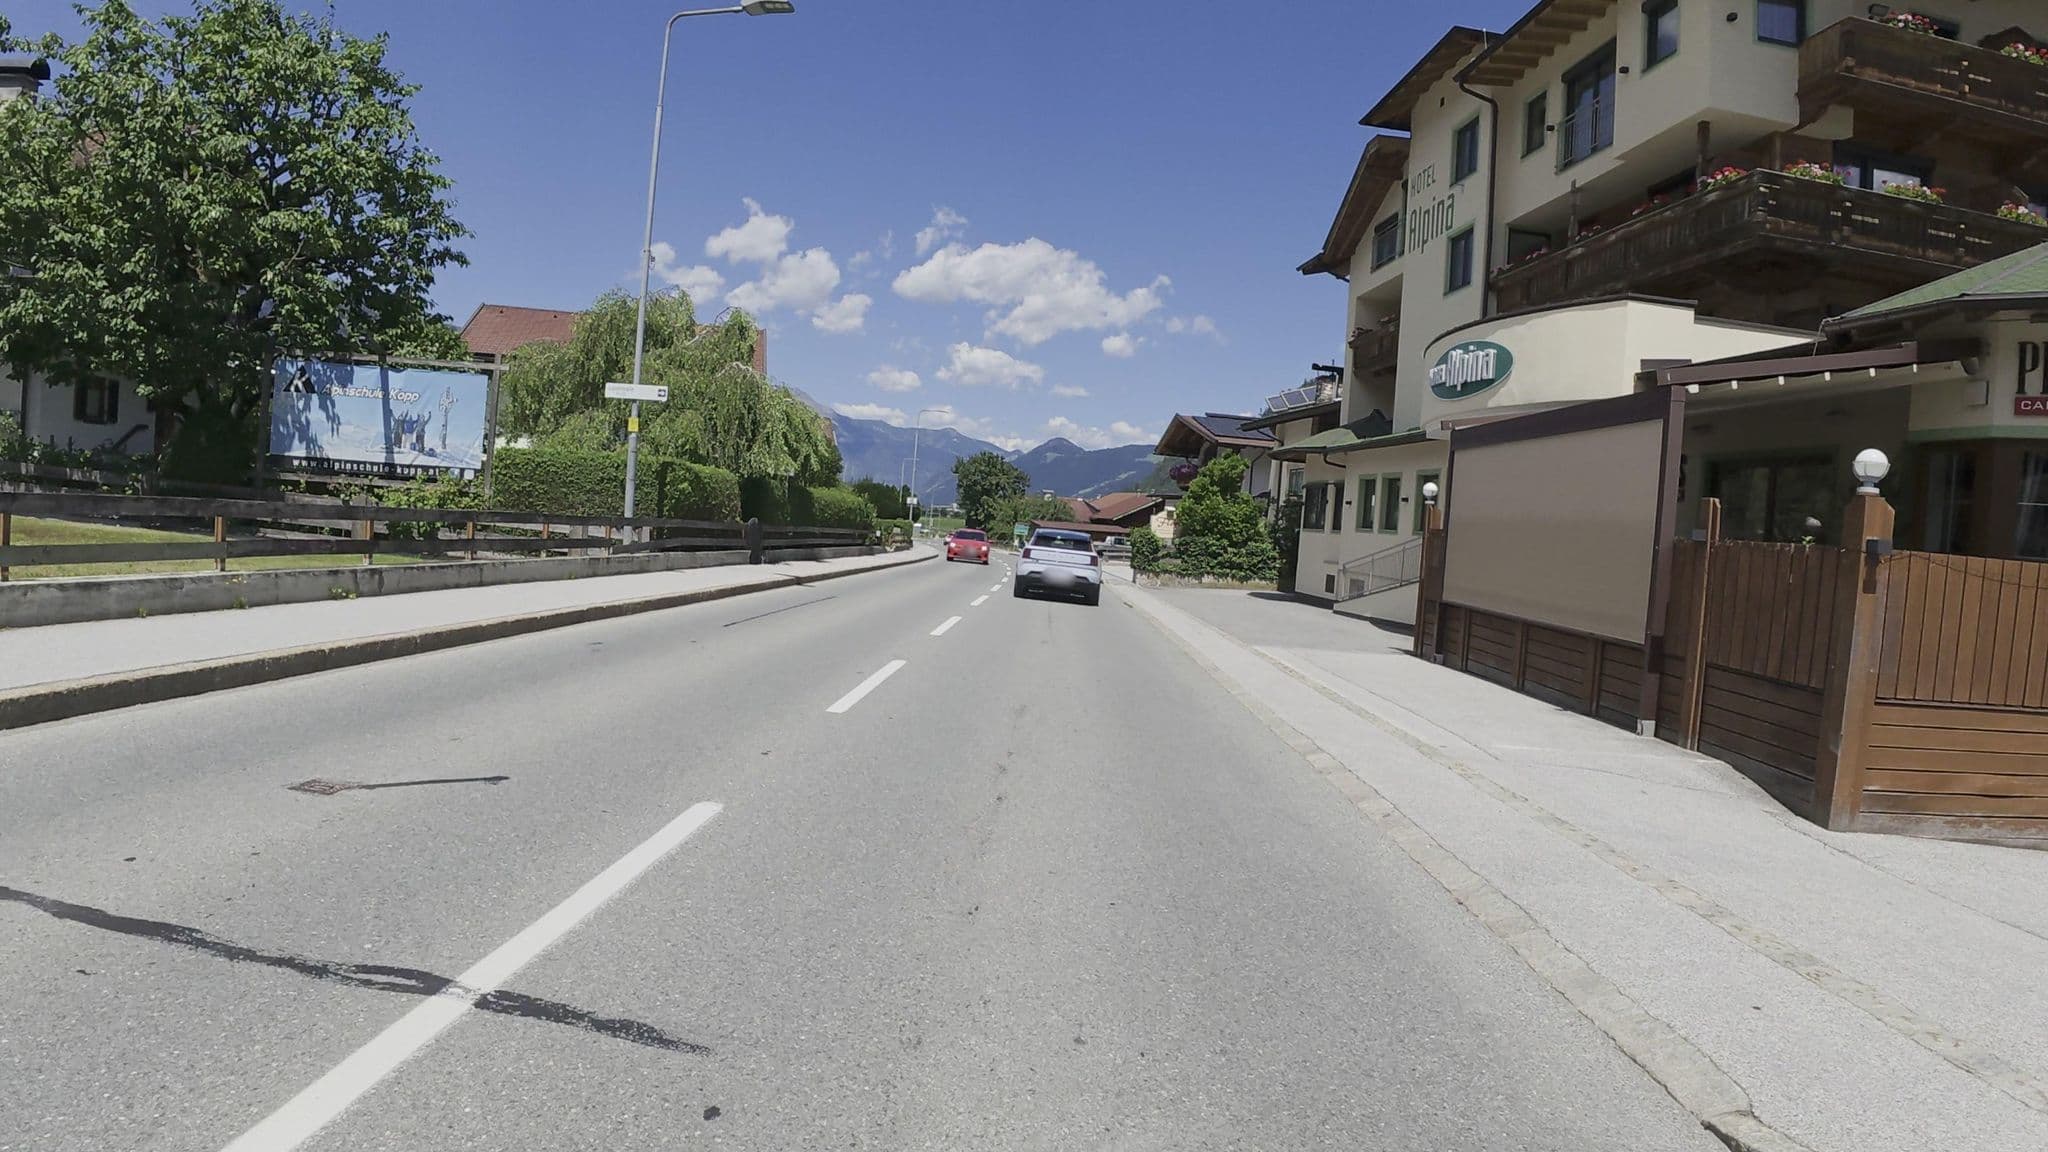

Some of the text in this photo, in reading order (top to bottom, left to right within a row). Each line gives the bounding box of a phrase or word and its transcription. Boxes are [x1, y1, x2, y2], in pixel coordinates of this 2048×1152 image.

[1411, 164, 1437, 195] HOTEL
[1408, 193, 1456, 254] Alpina
[1446, 345, 1498, 391] Alpina
[322, 383, 420, 404] Alpinschule Kopp
[2020, 400, 2048, 410] CA
